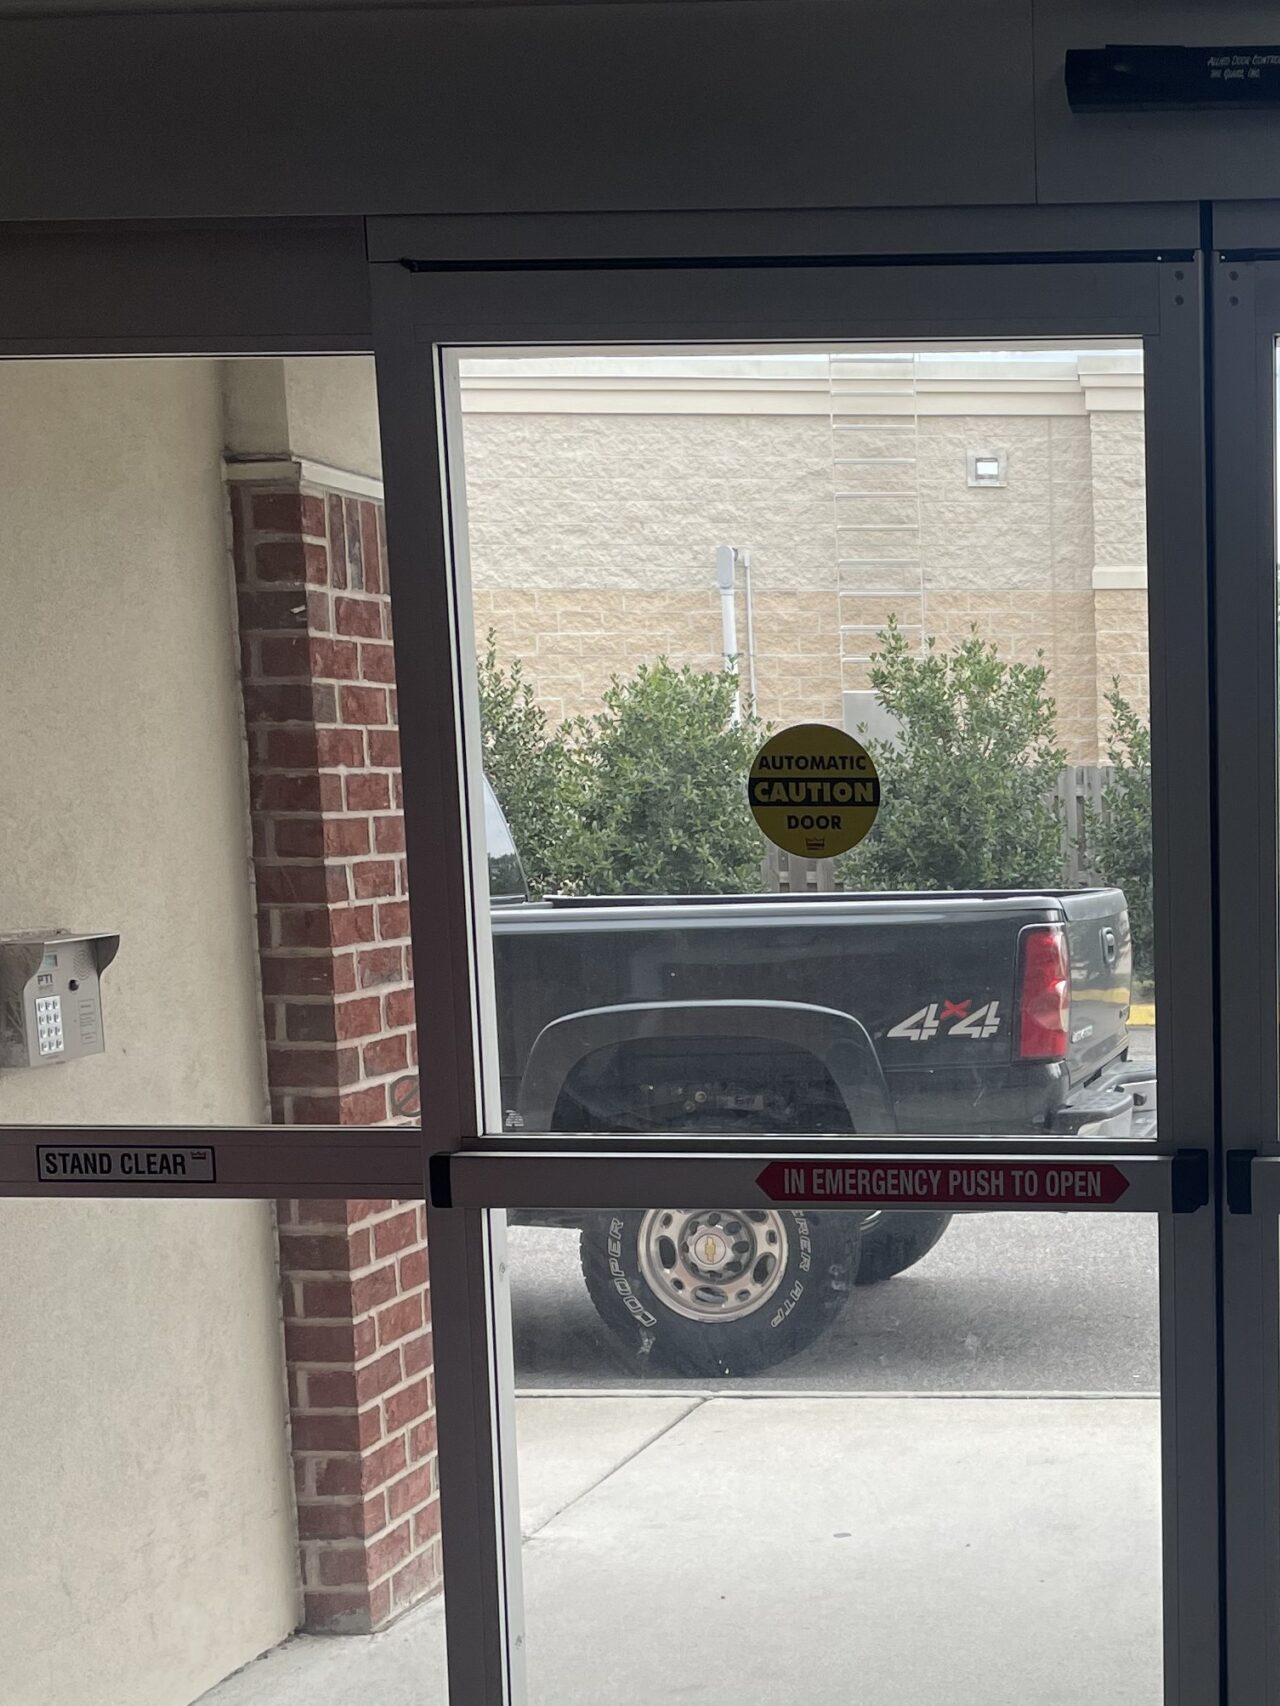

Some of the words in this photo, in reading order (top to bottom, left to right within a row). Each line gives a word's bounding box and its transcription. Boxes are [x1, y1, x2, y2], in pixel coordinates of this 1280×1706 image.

[758, 755, 867, 770] AUTOMATIC
[754, 782, 874, 803] CAUTION
[787, 815, 842, 830] DOOR
[45, 1152, 112, 1175] STAND
[120, 1153, 187, 1175] CLEAR
[784, 1168, 804, 1194] IN
[812, 1169, 942, 1196] EMERGENCY
[949, 1171, 1001, 1197] PUSH
[1011, 1171, 1042, 1196] TO
[1047, 1171, 1101, 1197] OPEN
[608, 1217, 657, 1328] COOPER
